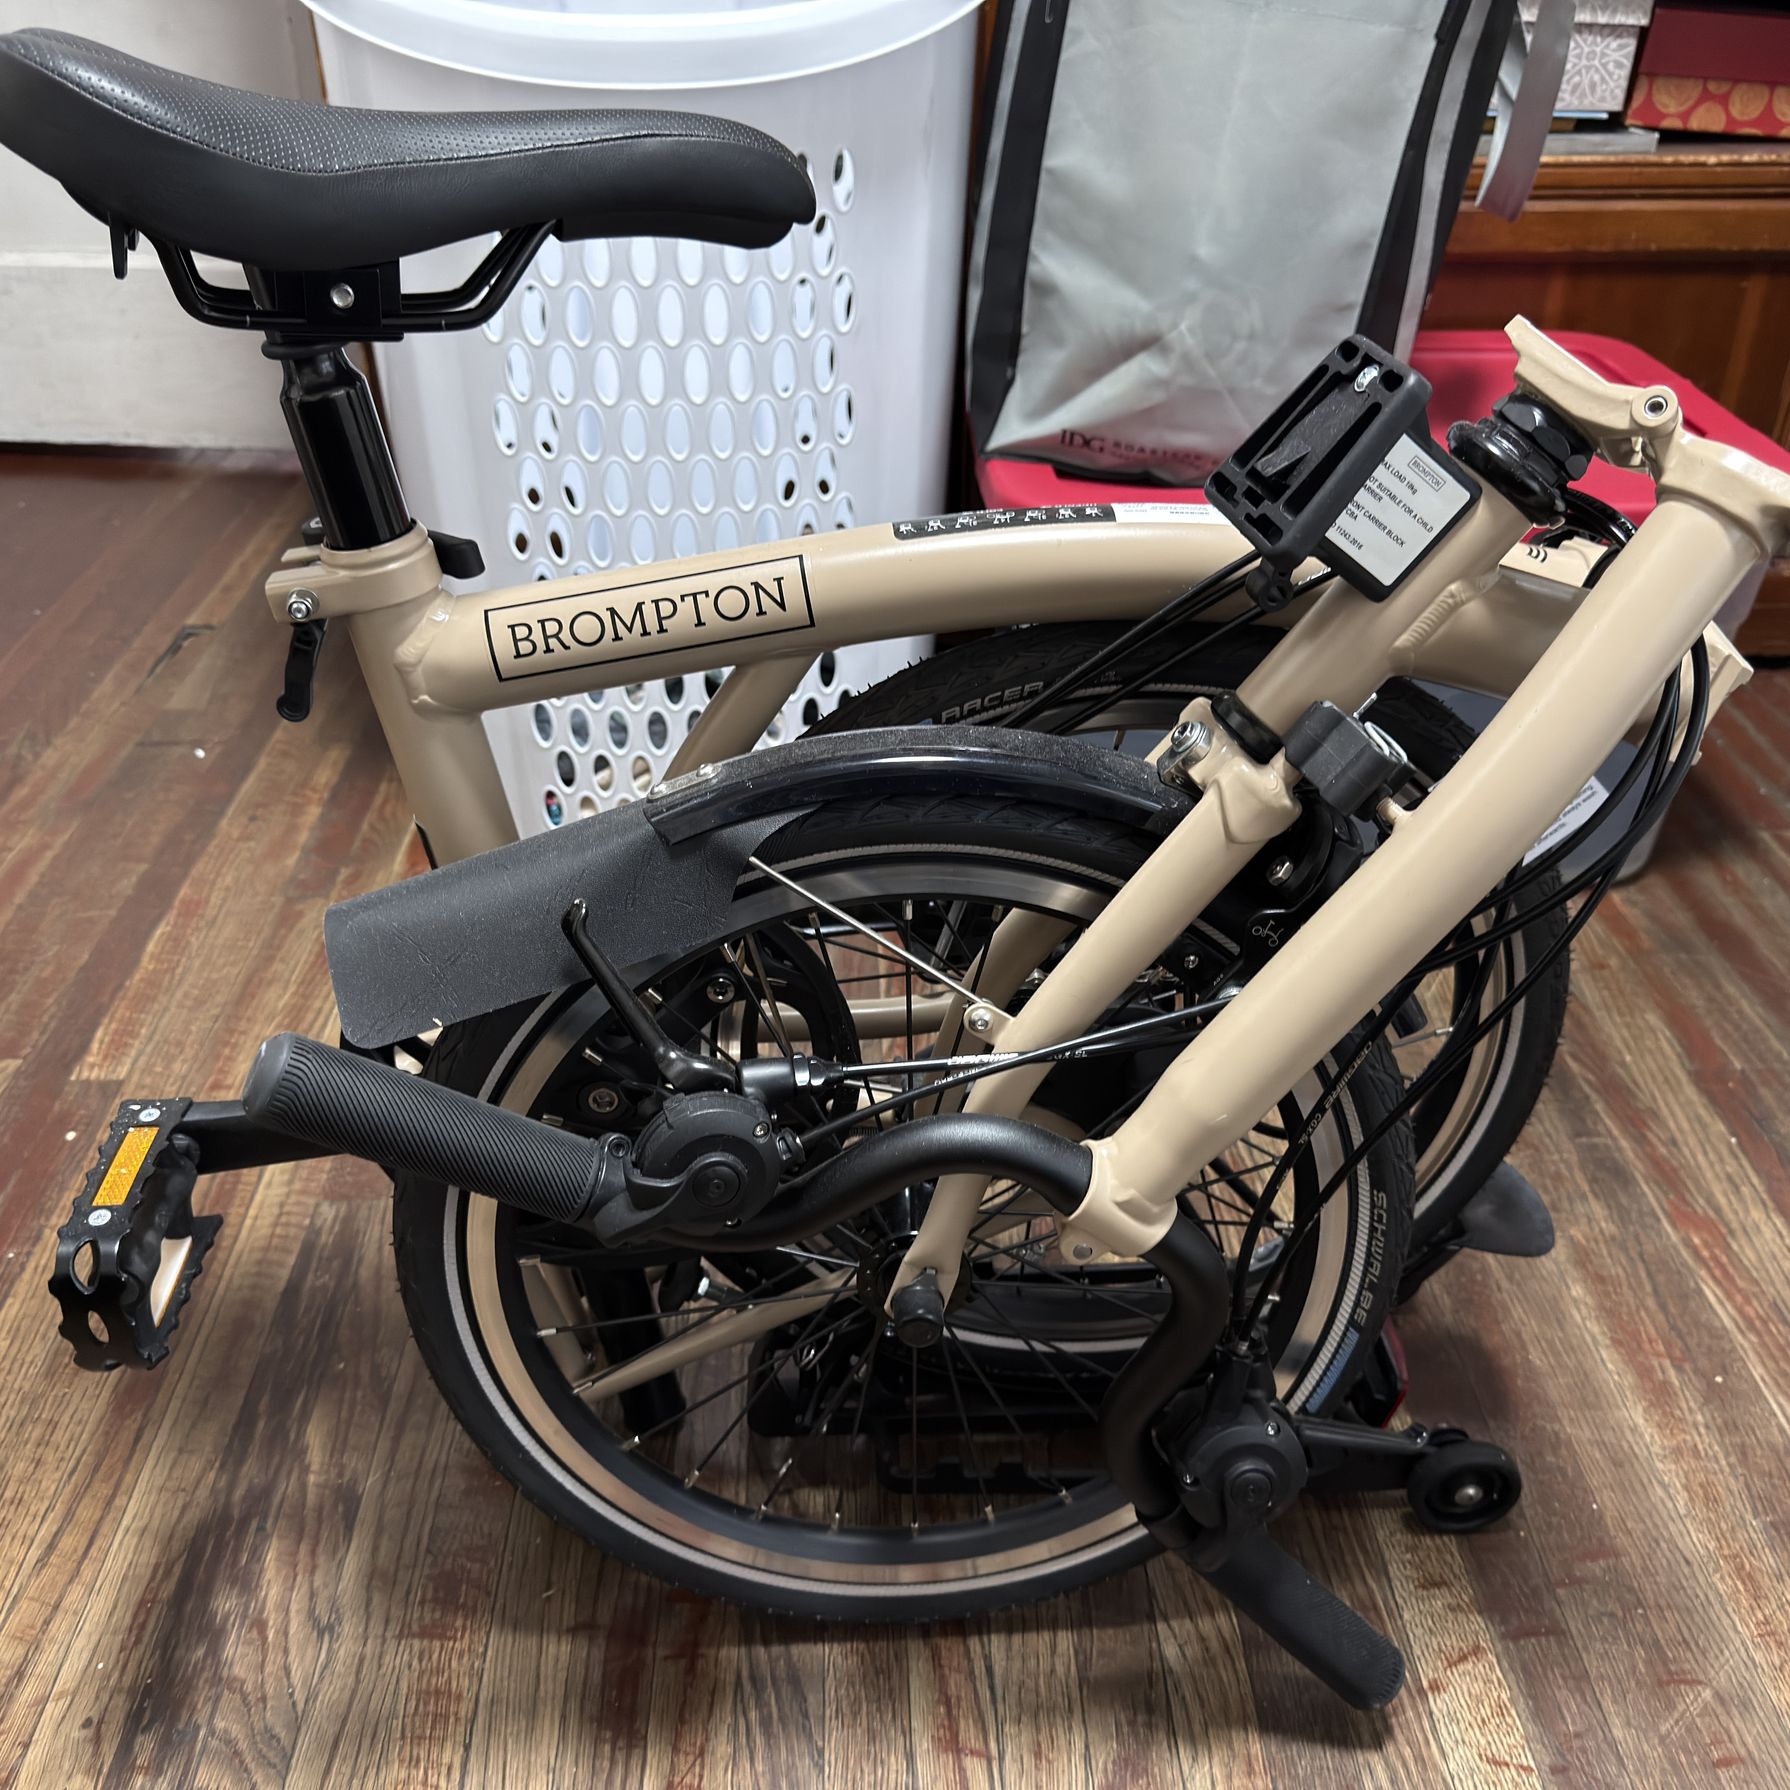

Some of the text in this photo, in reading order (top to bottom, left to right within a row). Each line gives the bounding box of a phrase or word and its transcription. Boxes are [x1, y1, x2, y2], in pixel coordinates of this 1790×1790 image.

[1390, 467, 1407, 484] LOAD
[1411, 459, 1442, 488] BROMPTON
[1363, 484, 1383, 503] ARRIER
[1368, 475, 1378, 485] OT
[1376, 482, 1403, 507] SUITABLE
[1400, 503, 1414, 517] FOR
[1416, 517, 1434, 533] CHILD
[1345, 508, 1358, 521] CBA
[1363, 510, 1388, 533] CARRIER
[1386, 529, 1406, 548] BLOCK
[507, 576, 787, 659] BROMPTON
[941, 681, 1044, 724] RACER
[1354, 1189, 1387, 1327] SCHWALBE
